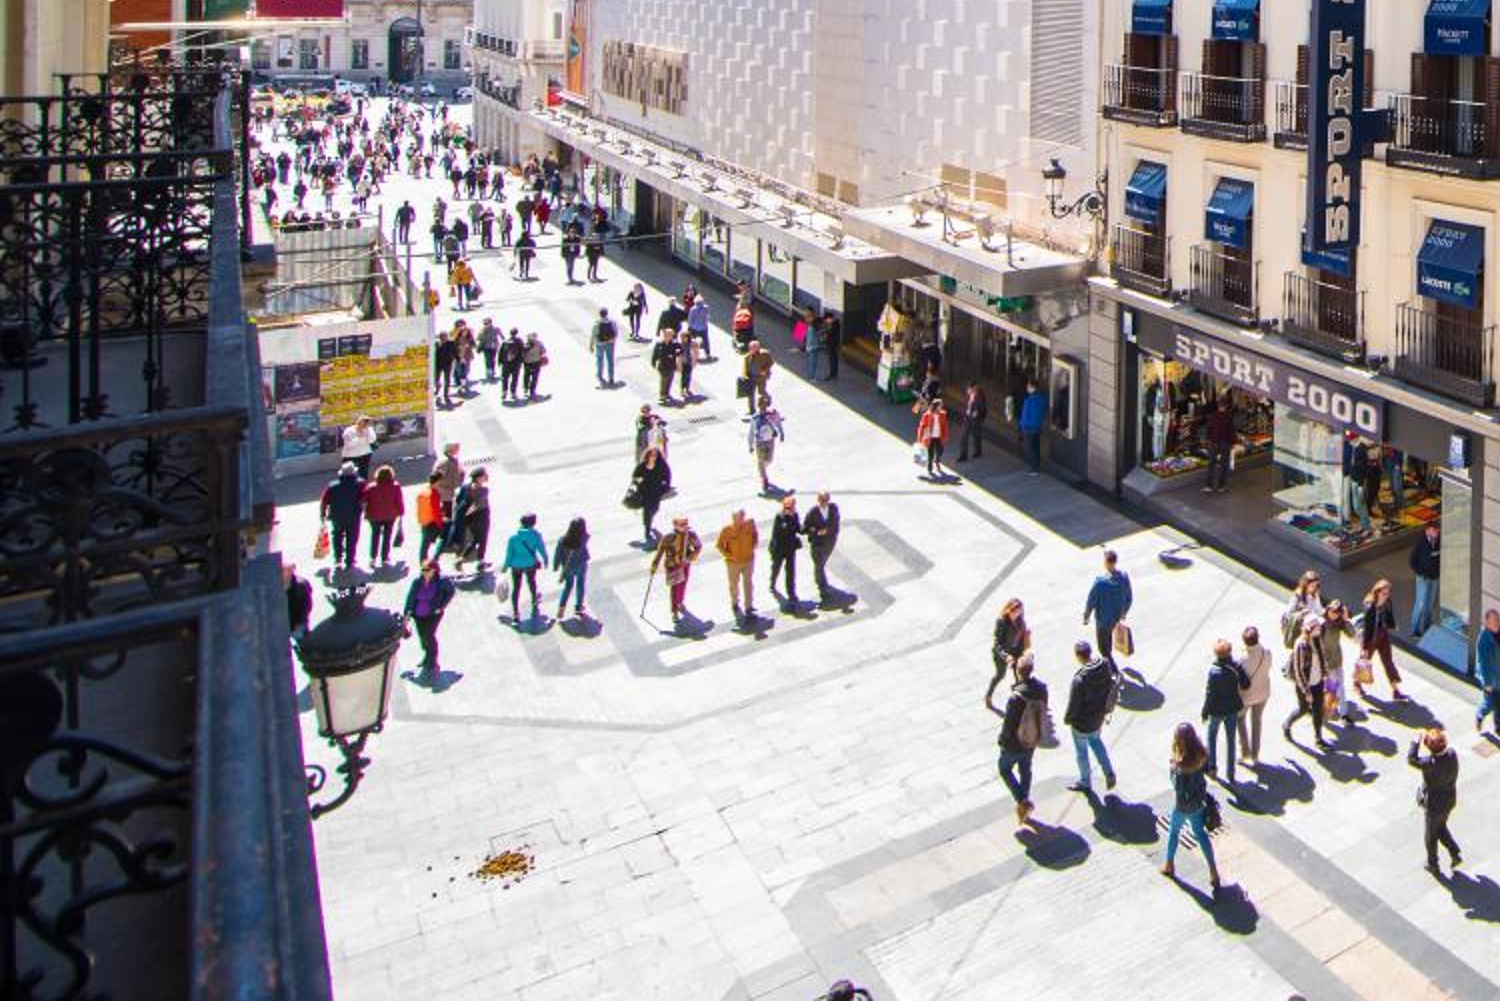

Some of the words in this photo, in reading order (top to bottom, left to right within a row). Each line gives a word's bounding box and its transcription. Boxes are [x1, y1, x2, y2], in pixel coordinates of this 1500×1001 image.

[1326, 30, 1354, 244] SPORT
[1174, 334, 1275, 393] SPORT
[1287, 376, 1379, 433] 2000
